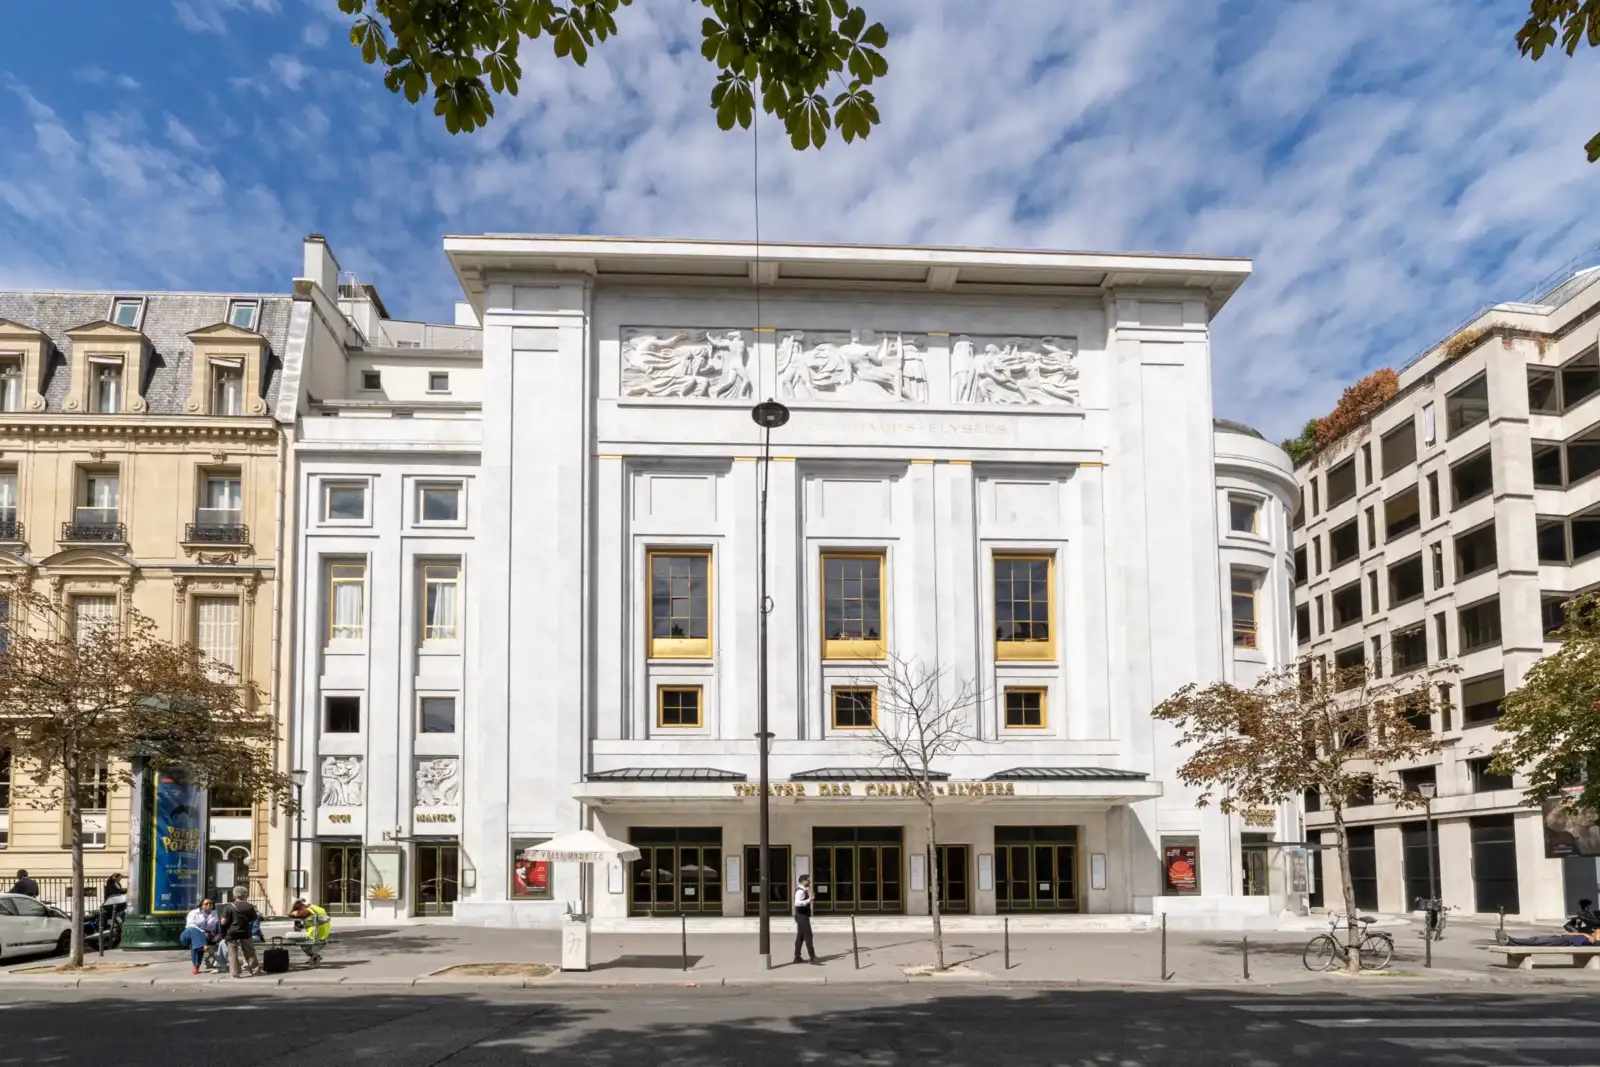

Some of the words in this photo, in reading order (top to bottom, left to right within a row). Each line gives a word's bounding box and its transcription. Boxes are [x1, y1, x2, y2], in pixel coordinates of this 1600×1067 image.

[819, 782, 852, 796] DES
[865, 782, 1016, 796] CHAM-ELYSEES
[162, 836, 201, 853] POTTER
